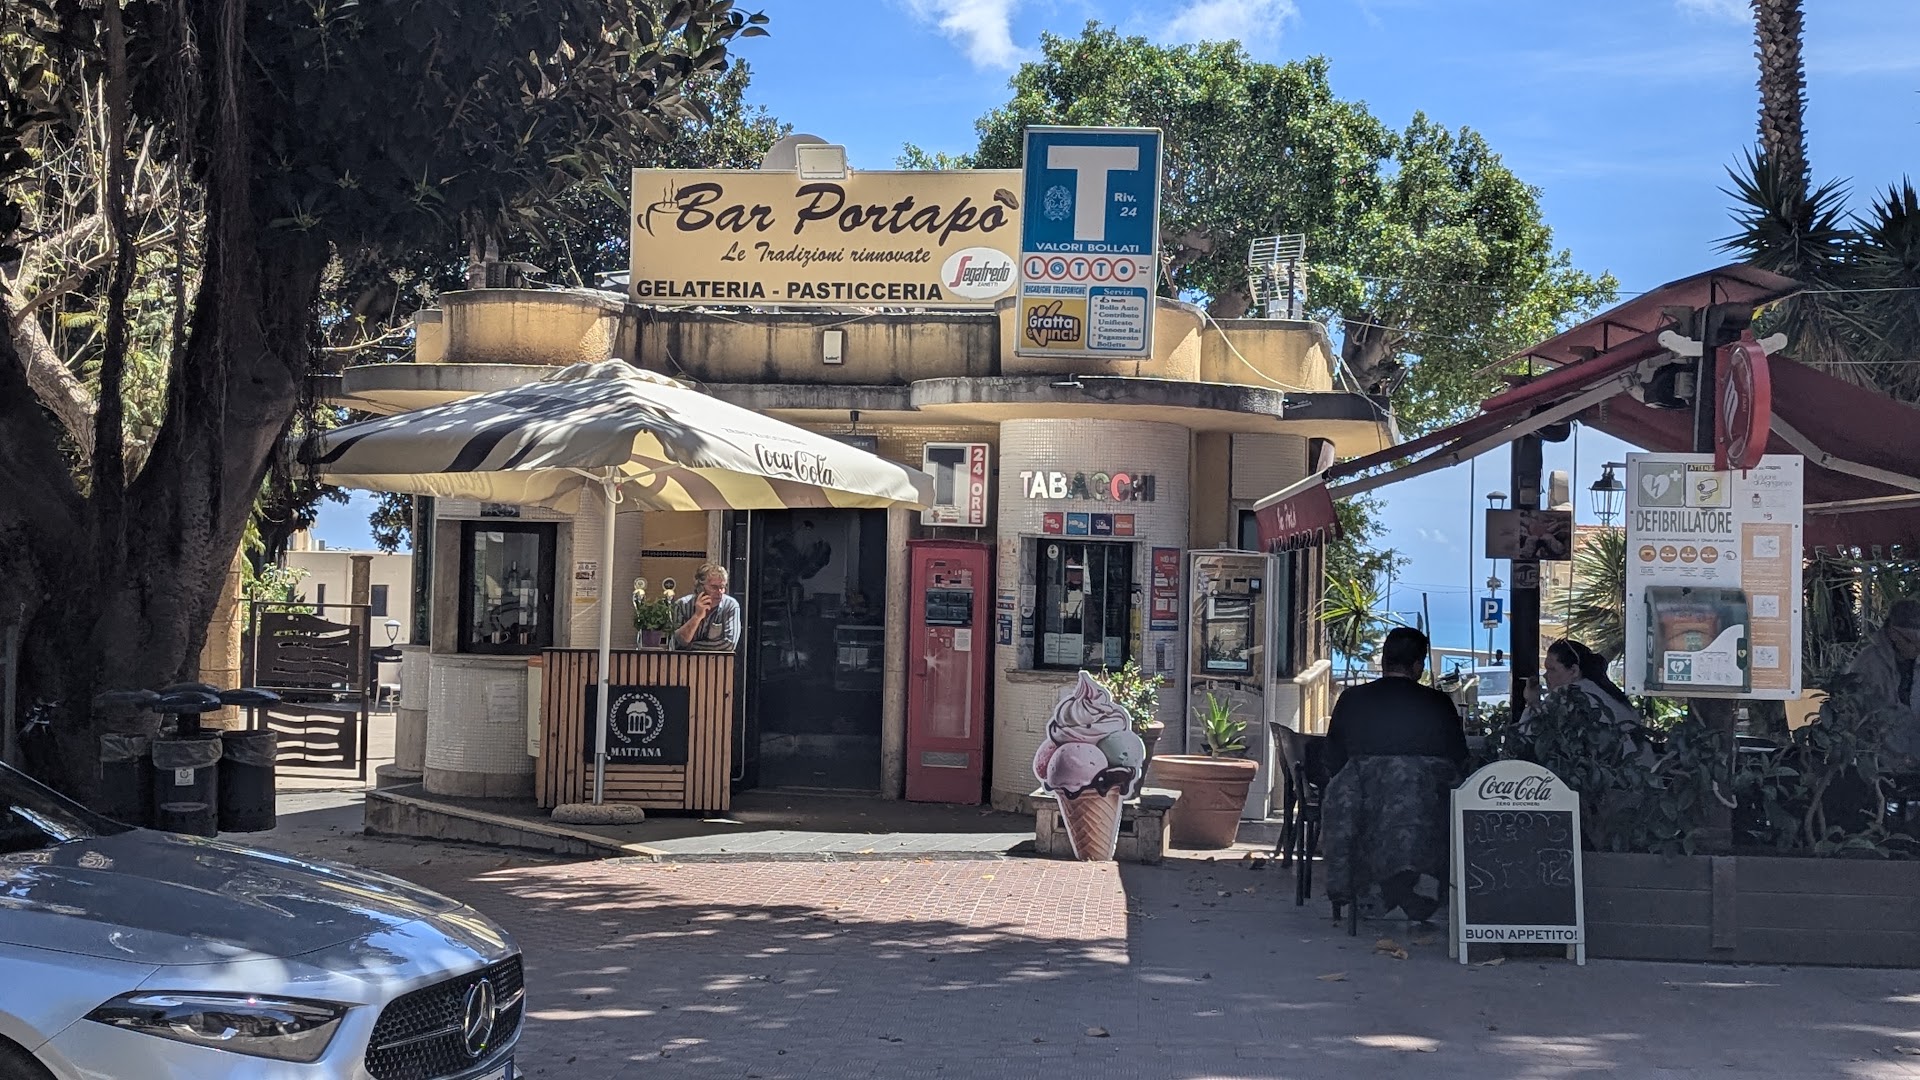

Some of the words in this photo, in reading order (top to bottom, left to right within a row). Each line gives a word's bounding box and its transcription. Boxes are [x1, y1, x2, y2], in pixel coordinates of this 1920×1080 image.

[1047, 145, 1139, 241] T
[1114, 192, 1137, 202] Riv.
[674, 182, 775, 233] Bar
[1120, 207, 1138, 217] 24
[720, 241, 746, 262] Le
[754, 241, 844, 268] Tradizioni
[850, 248, 931, 263] rinnovate
[1035, 242, 1083, 252] VALORI
[1087, 243, 1139, 253] BOLLATI
[949, 256, 1011, 287] Segafredo
[1024, 256, 1136, 282] LOTTO
[636, 280, 766, 298] GELATERIA
[787, 282, 943, 300] PASTICCERIA
[1029, 315, 1073, 328] Gratta
[754, 443, 835, 486] Coca-Cola
[972, 448, 984, 475] 24
[927, 447, 966, 506] T
[1020, 471, 1156, 501] TABACCHI
[970, 482, 983, 523] ORE
[1636, 510, 1732, 534] DEFIBRILLATORE
[1484, 601, 1498, 619] P
[610, 747, 661, 757] MATTANA
[1478, 775, 1555, 801] Coca-Cola
[1465, 928, 1507, 941] BUON
[1507, 929, 1578, 941] APPETITO!
